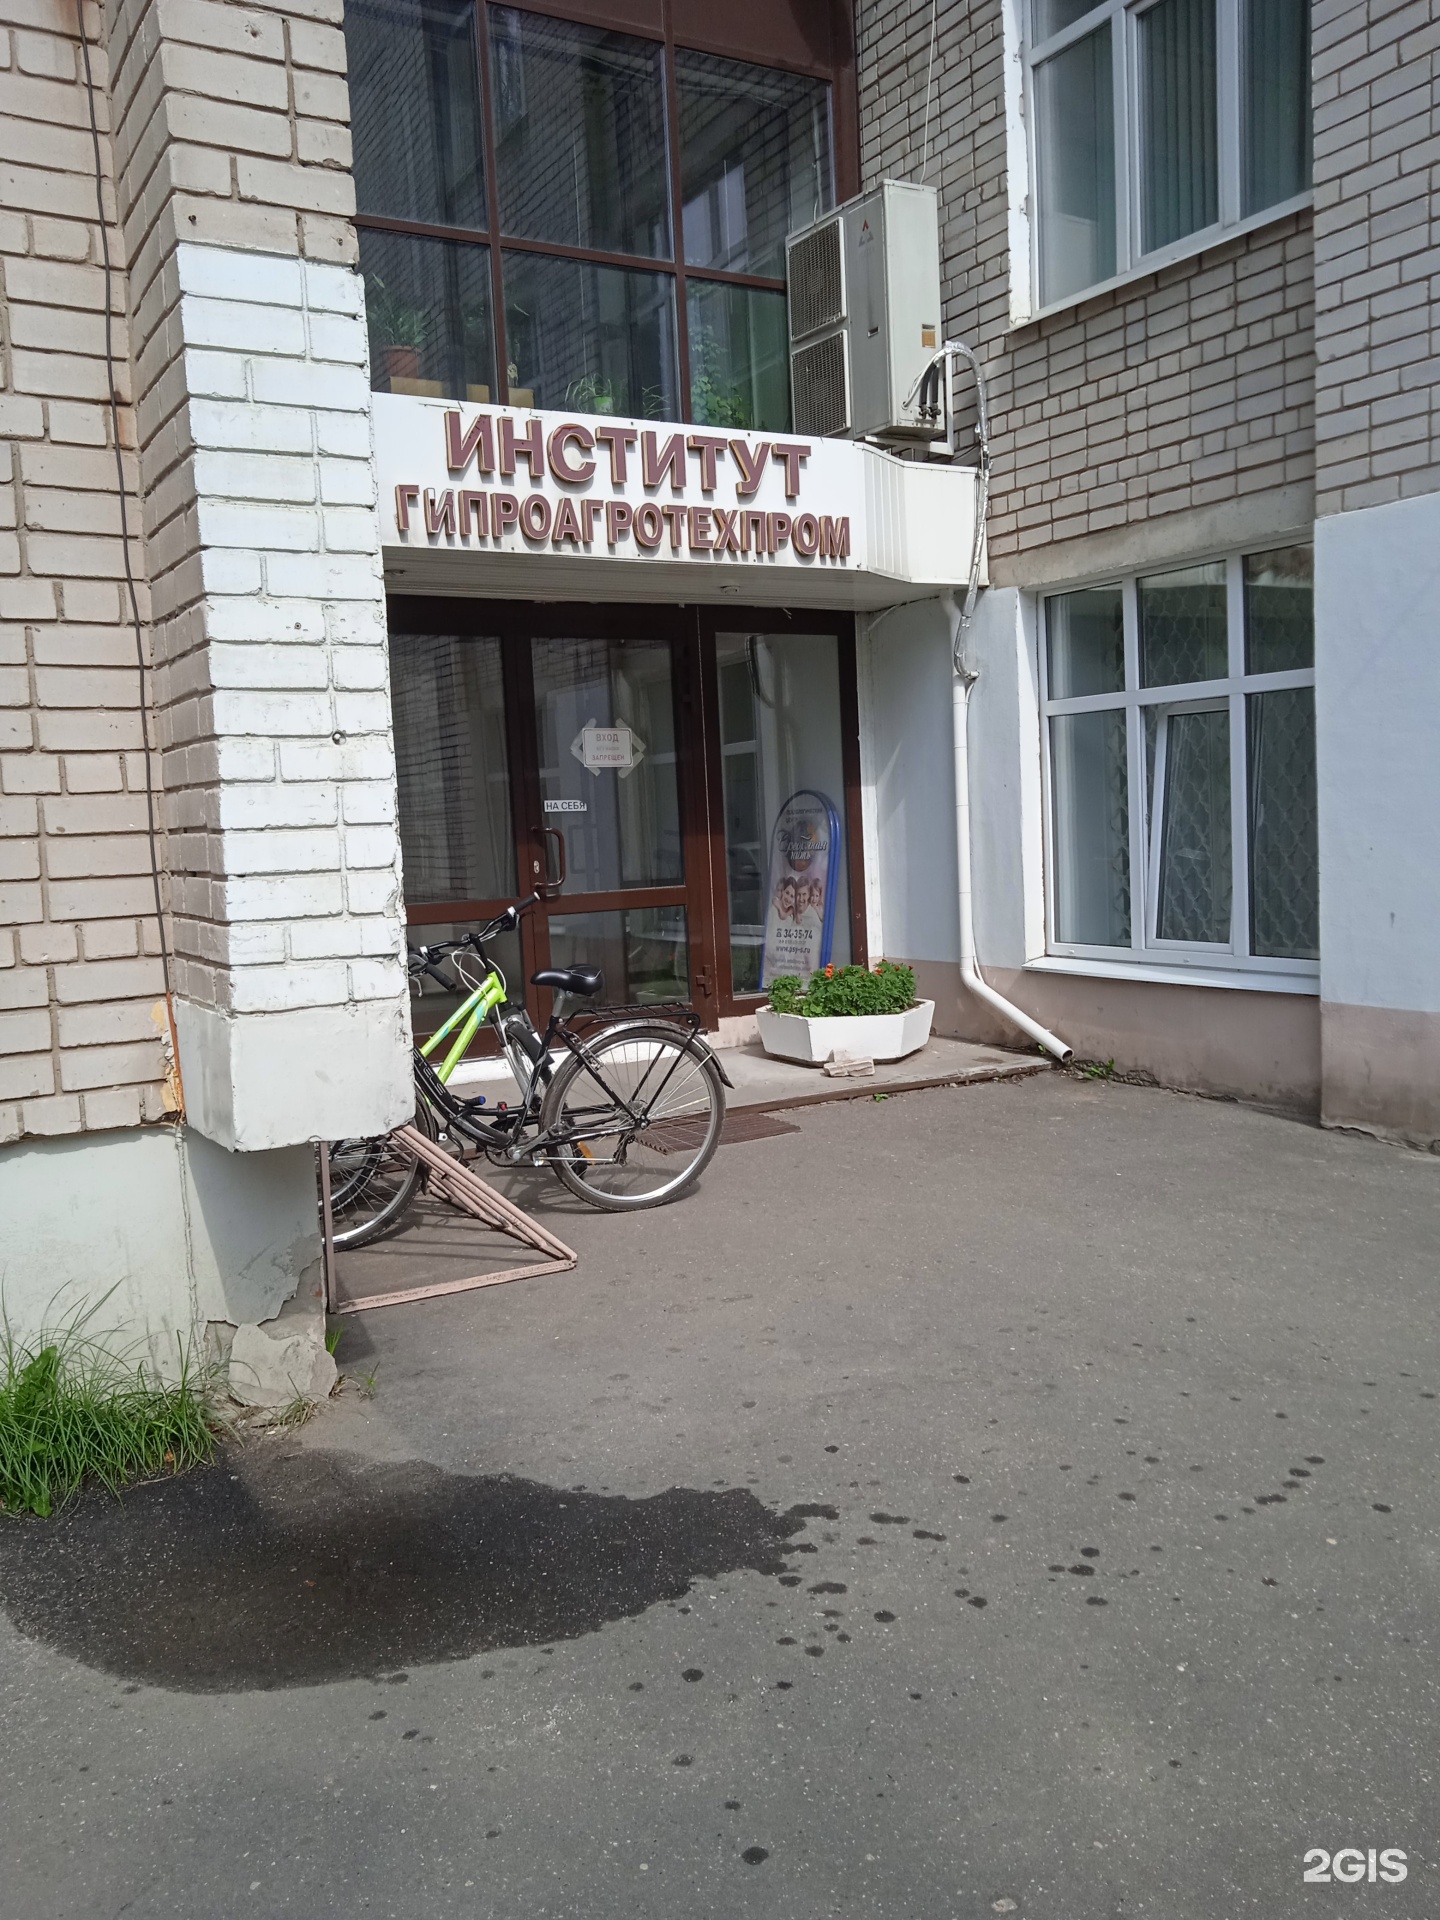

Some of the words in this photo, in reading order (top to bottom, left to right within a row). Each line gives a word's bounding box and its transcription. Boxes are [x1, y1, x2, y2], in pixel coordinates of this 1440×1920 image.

[444, 411, 812, 498] ИНСТИТУТ
[395, 484, 851, 558] ГИПРОАГРОТЕХПРОМ
[596, 733, 619, 743] ВХОД
[546, 802, 559, 810] НА
[561, 801, 585, 810] СЕБЯ
